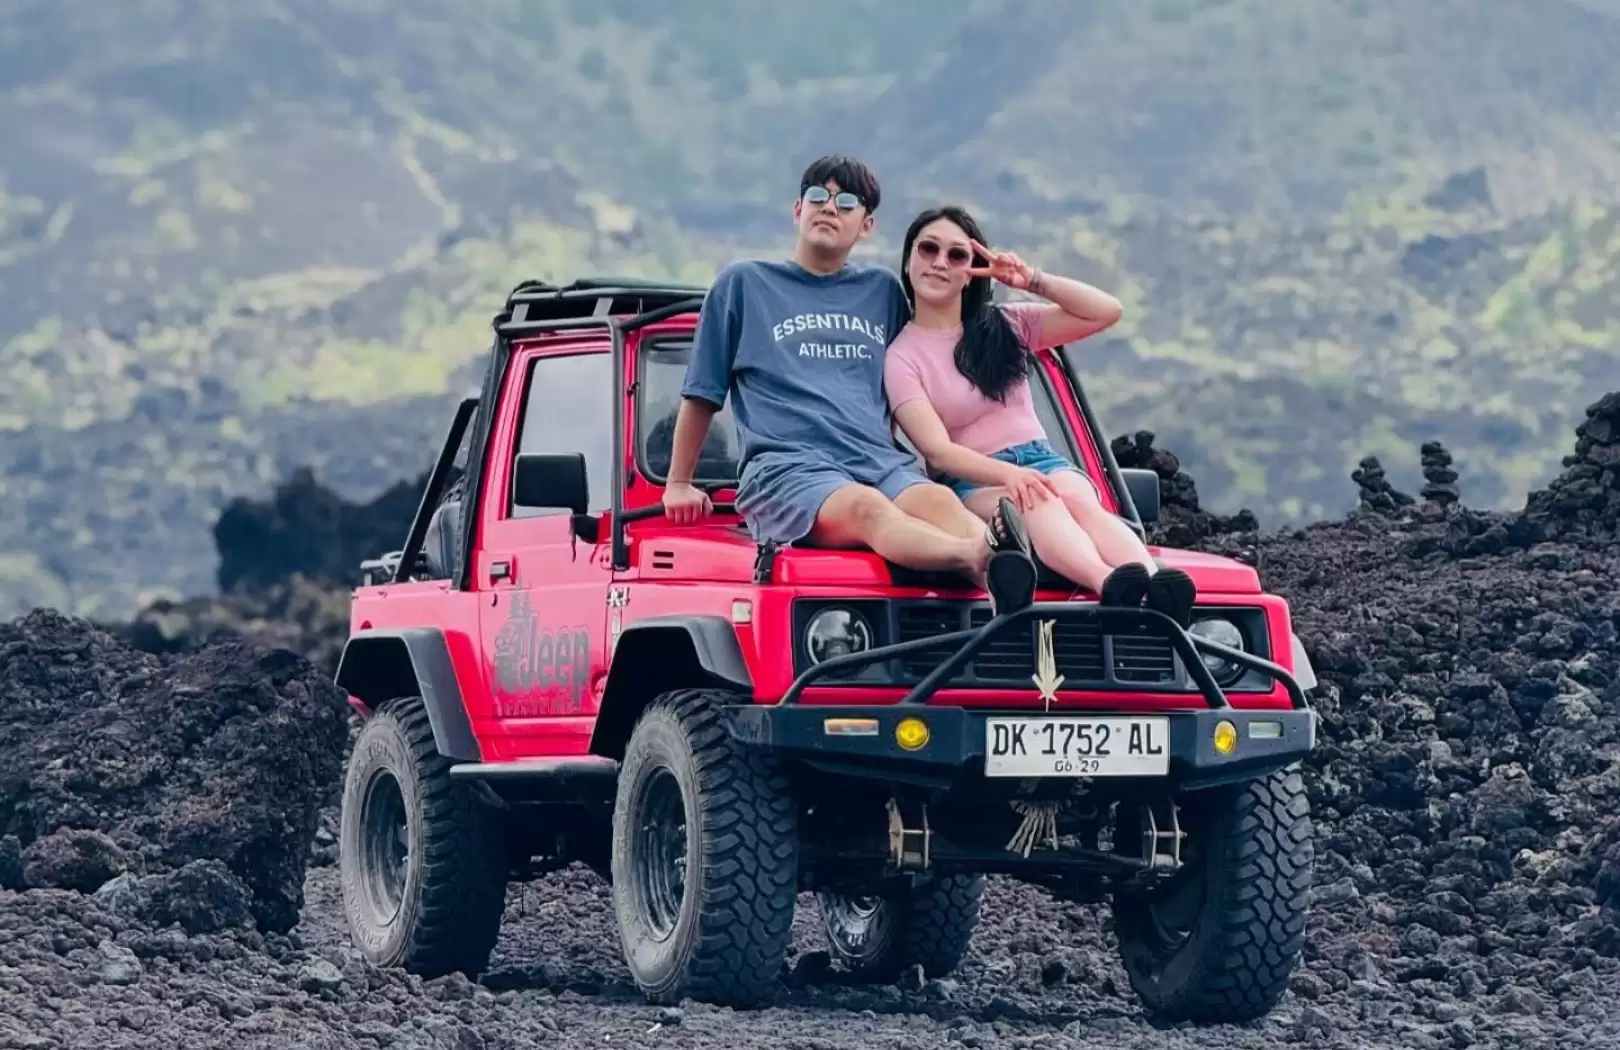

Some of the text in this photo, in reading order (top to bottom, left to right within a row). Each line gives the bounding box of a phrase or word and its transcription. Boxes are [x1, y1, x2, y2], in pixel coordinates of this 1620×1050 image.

[773, 313, 885, 345] ESSENTIALS
[519, 613, 590, 709] Jeep
[992, 723, 1163, 756] DK 1752 AL
